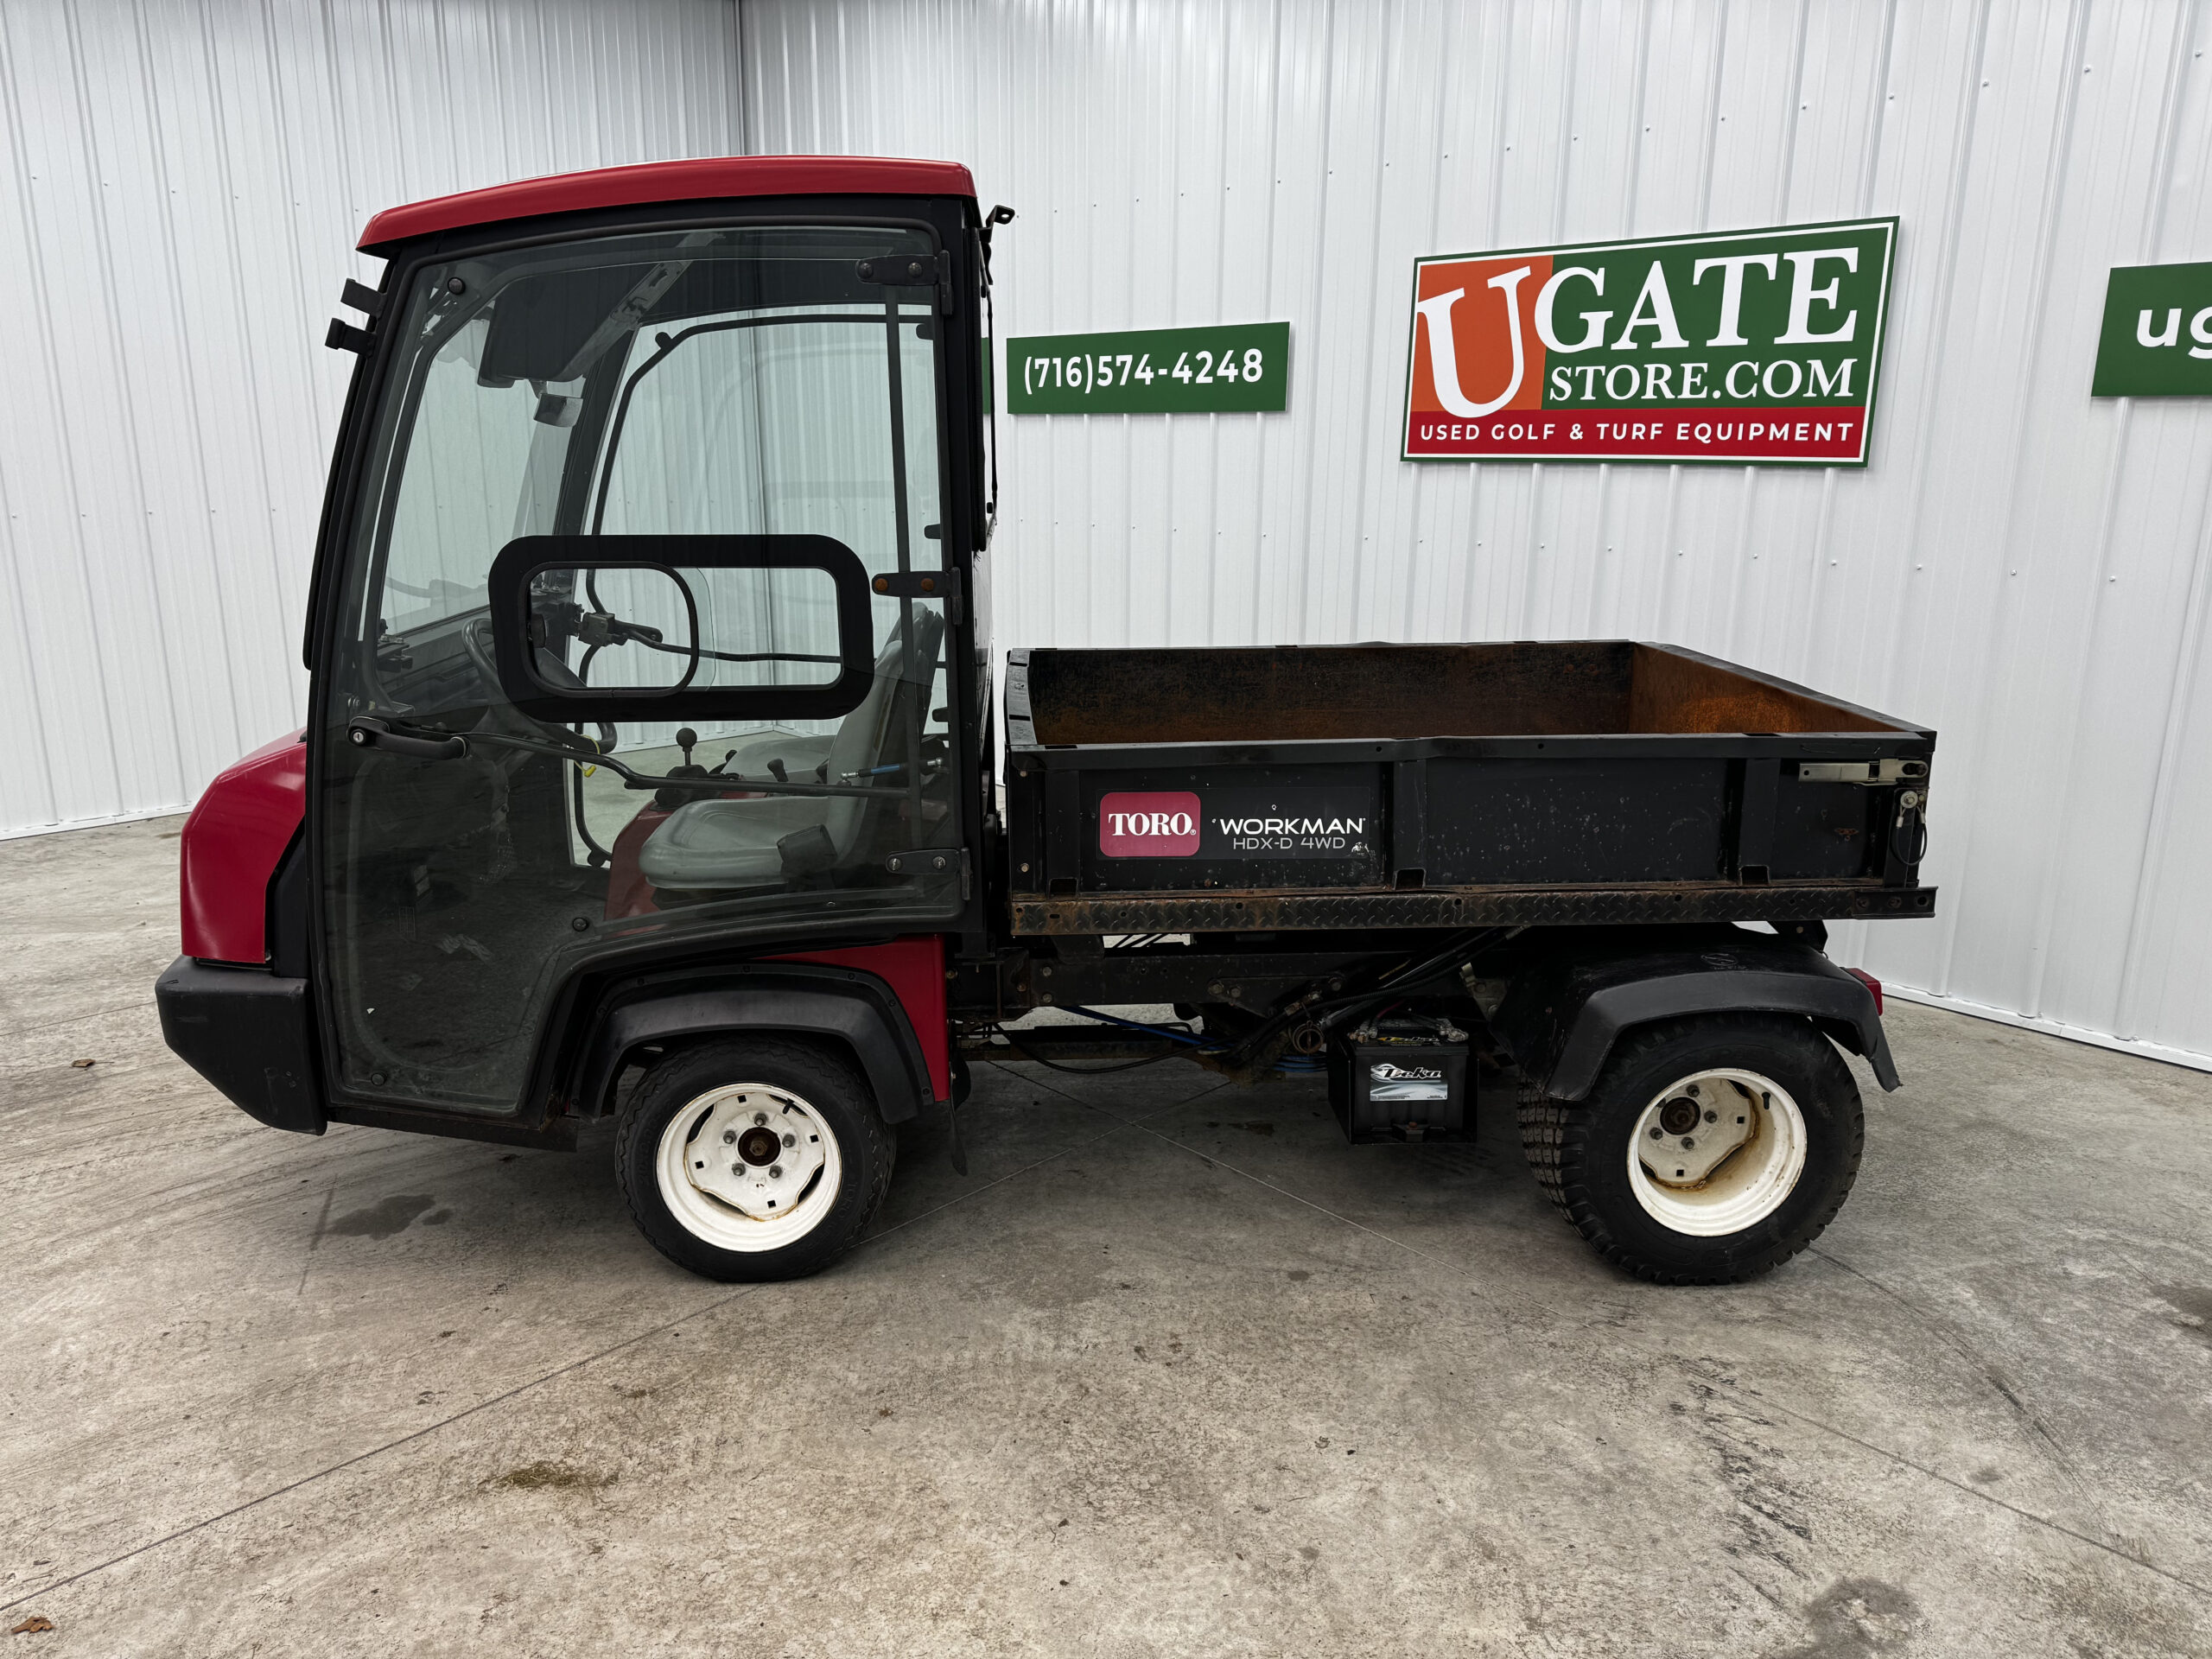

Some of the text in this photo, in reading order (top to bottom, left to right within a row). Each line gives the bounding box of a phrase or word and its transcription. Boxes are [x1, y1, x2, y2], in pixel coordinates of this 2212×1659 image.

[1024, 348, 1263, 395] (716)574-4248
[1549, 358, 1858, 401] STORE.COM
[1420, 423, 1854, 443] USED GOLF & TURF EQUIPMENT
[1109, 812, 1197, 836] TORO
[1219, 817, 1366, 836] WORKMAN
[1233, 836, 1346, 849] HDX-D 4WD
[1384, 1067, 1441, 1079] Deka
